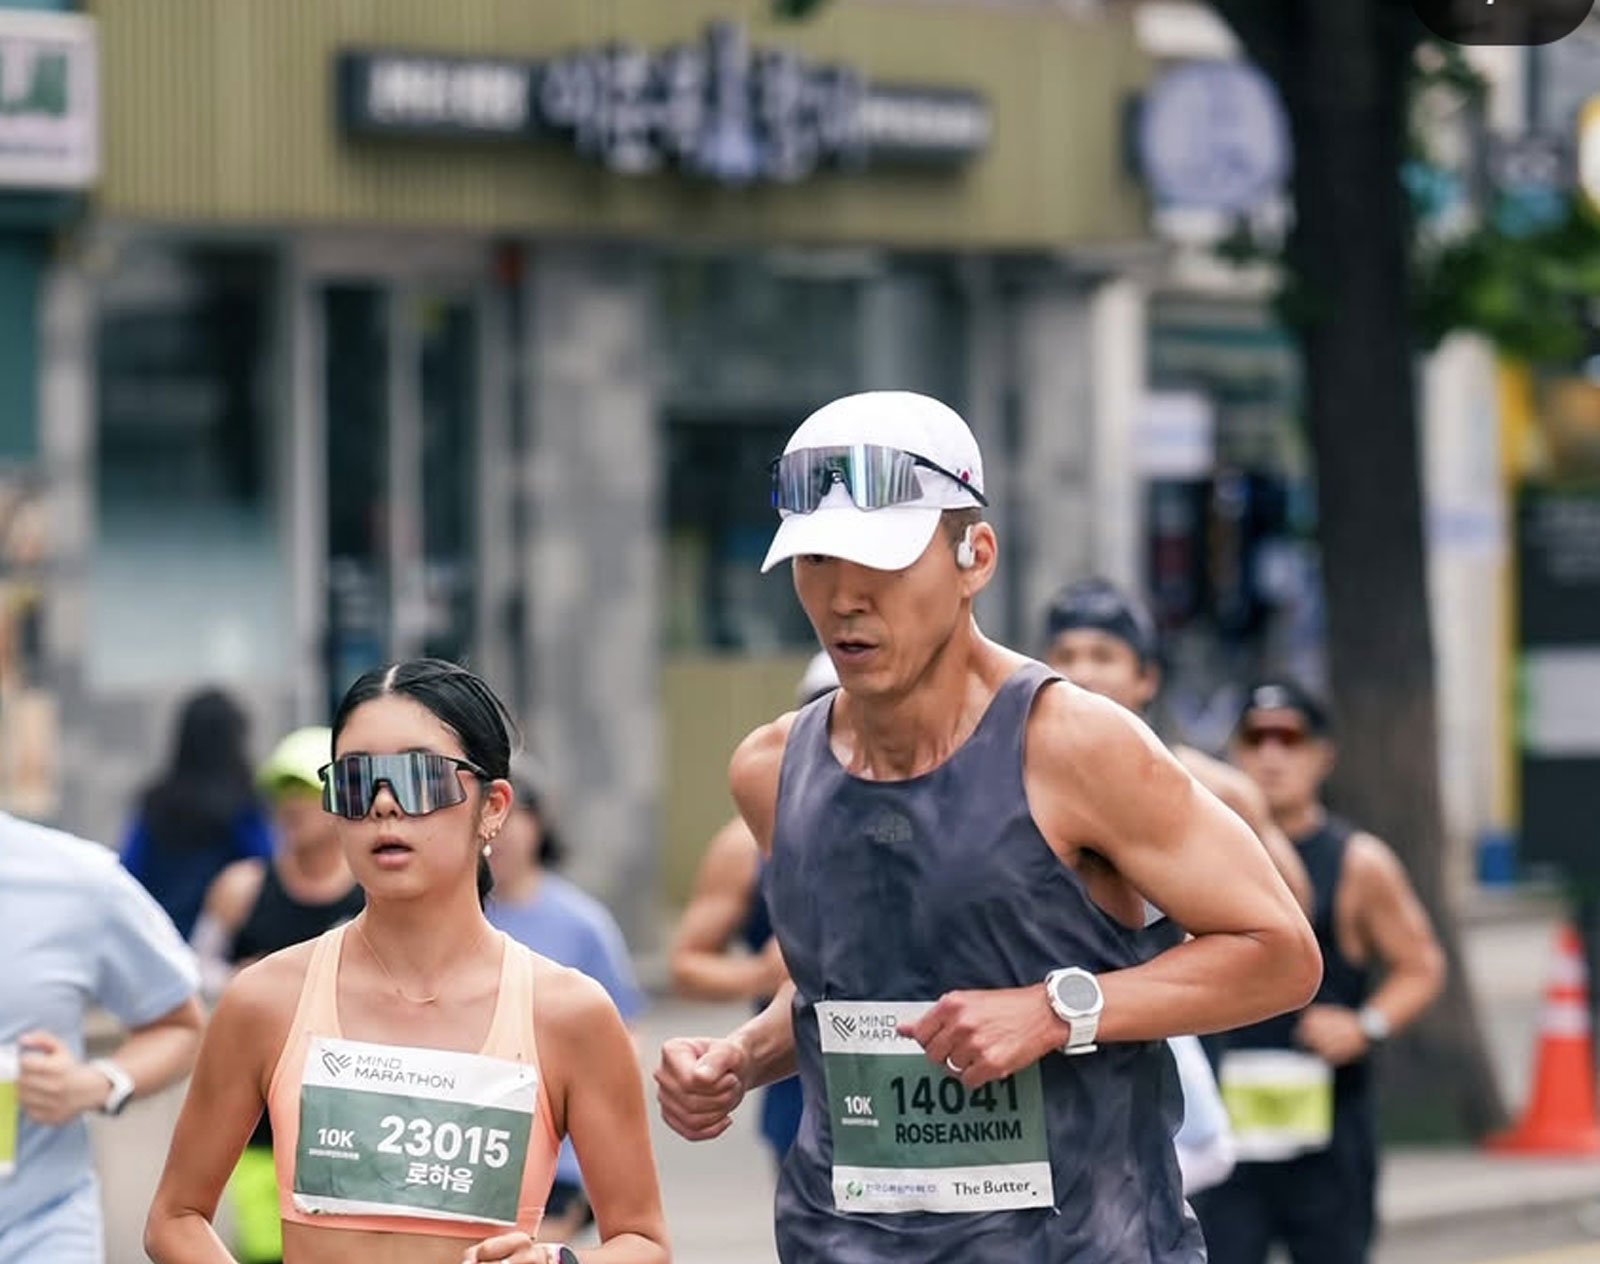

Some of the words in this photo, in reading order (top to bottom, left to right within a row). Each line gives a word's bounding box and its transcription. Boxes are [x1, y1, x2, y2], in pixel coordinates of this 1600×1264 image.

[859, 1015, 897, 1028] MIND
[356, 1054, 402, 1070] MIND
[354, 1066, 456, 1090] MARATHON
[890, 1074, 1018, 1115] 14041
[844, 1096, 873, 1116] 10K
[317, 1128, 356, 1149] 10K
[376, 1115, 512, 1169] 23015
[895, 1119, 1023, 1144] ROSEANKIM
[404, 1161, 475, 1194] 로하음
[952, 1182, 980, 1196] The
